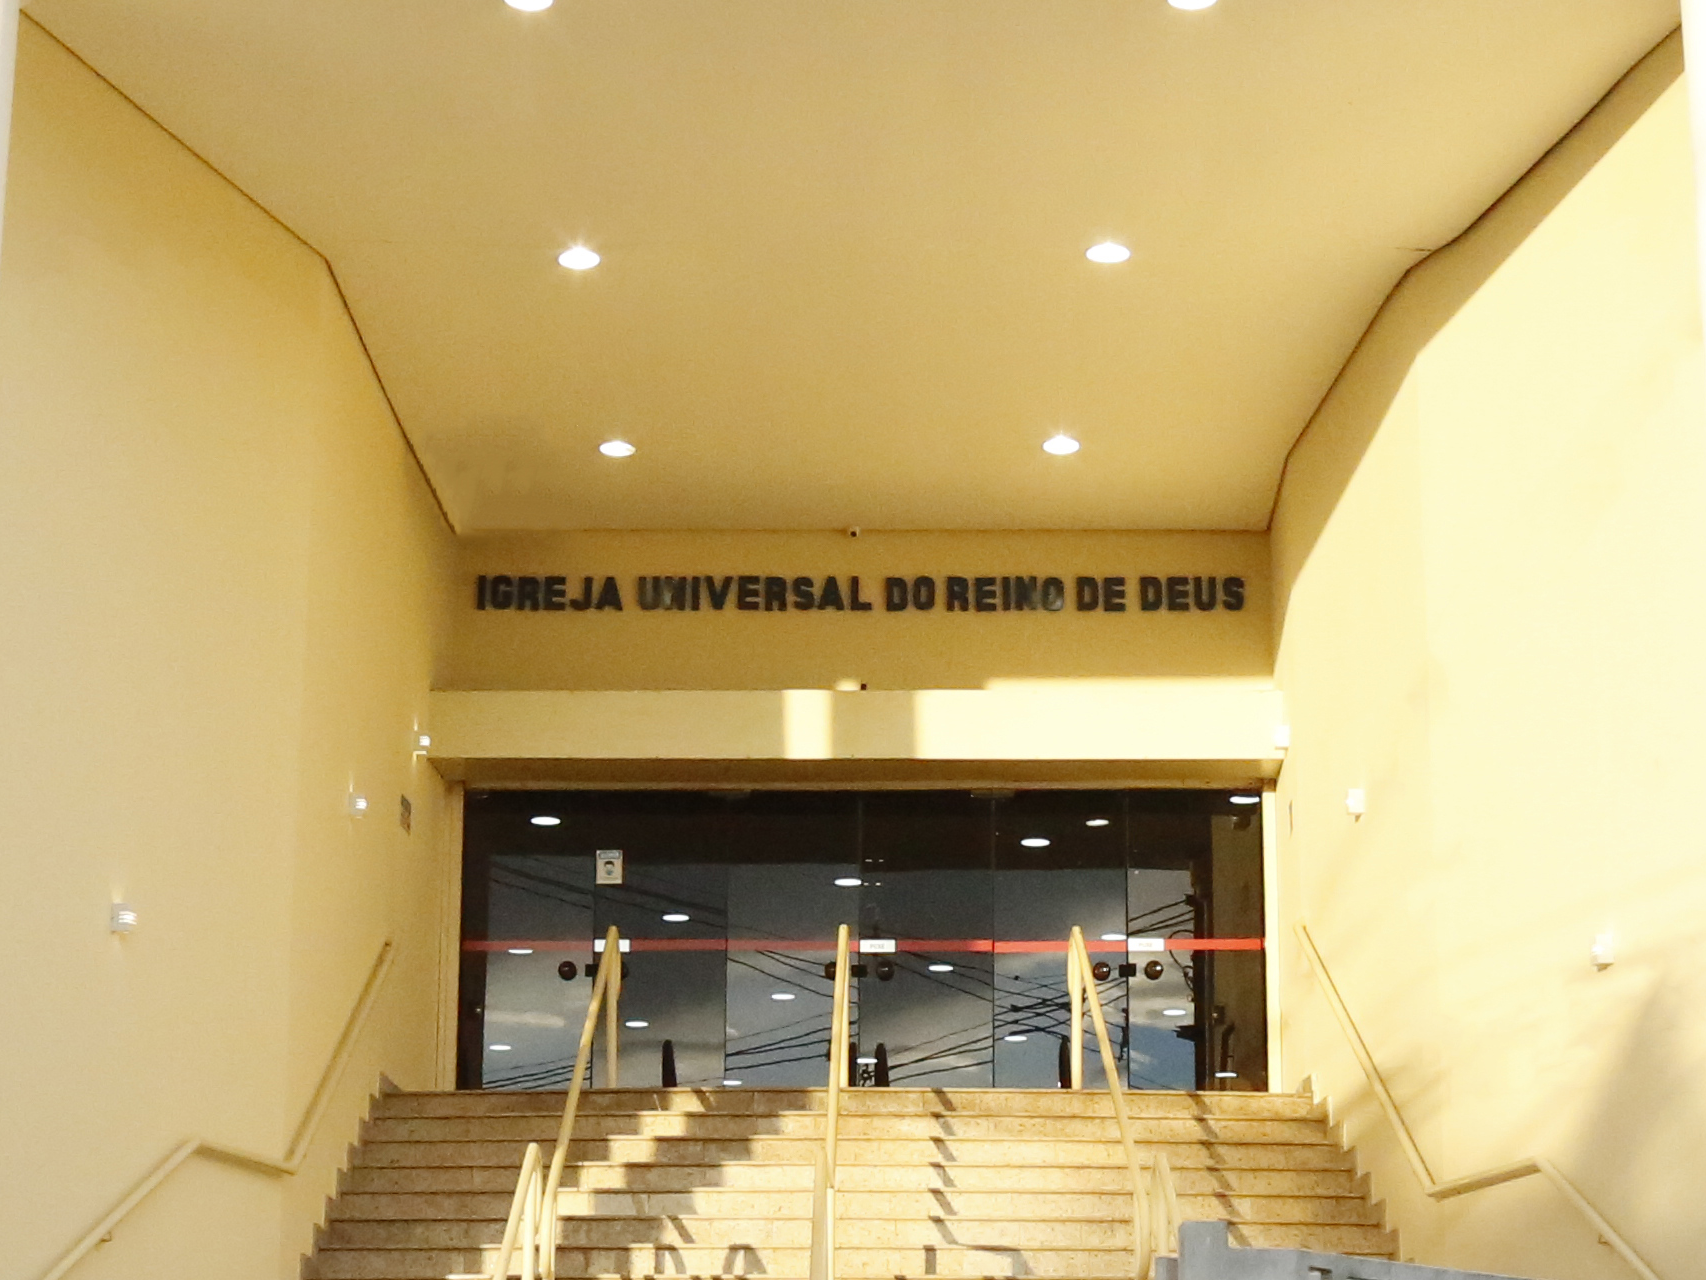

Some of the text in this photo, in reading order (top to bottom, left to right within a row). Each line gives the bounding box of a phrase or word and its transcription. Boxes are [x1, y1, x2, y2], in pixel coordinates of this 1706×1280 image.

[475, 574, 1246, 612] IGREJA UNIVERSAL DO REINO DE DEUS
